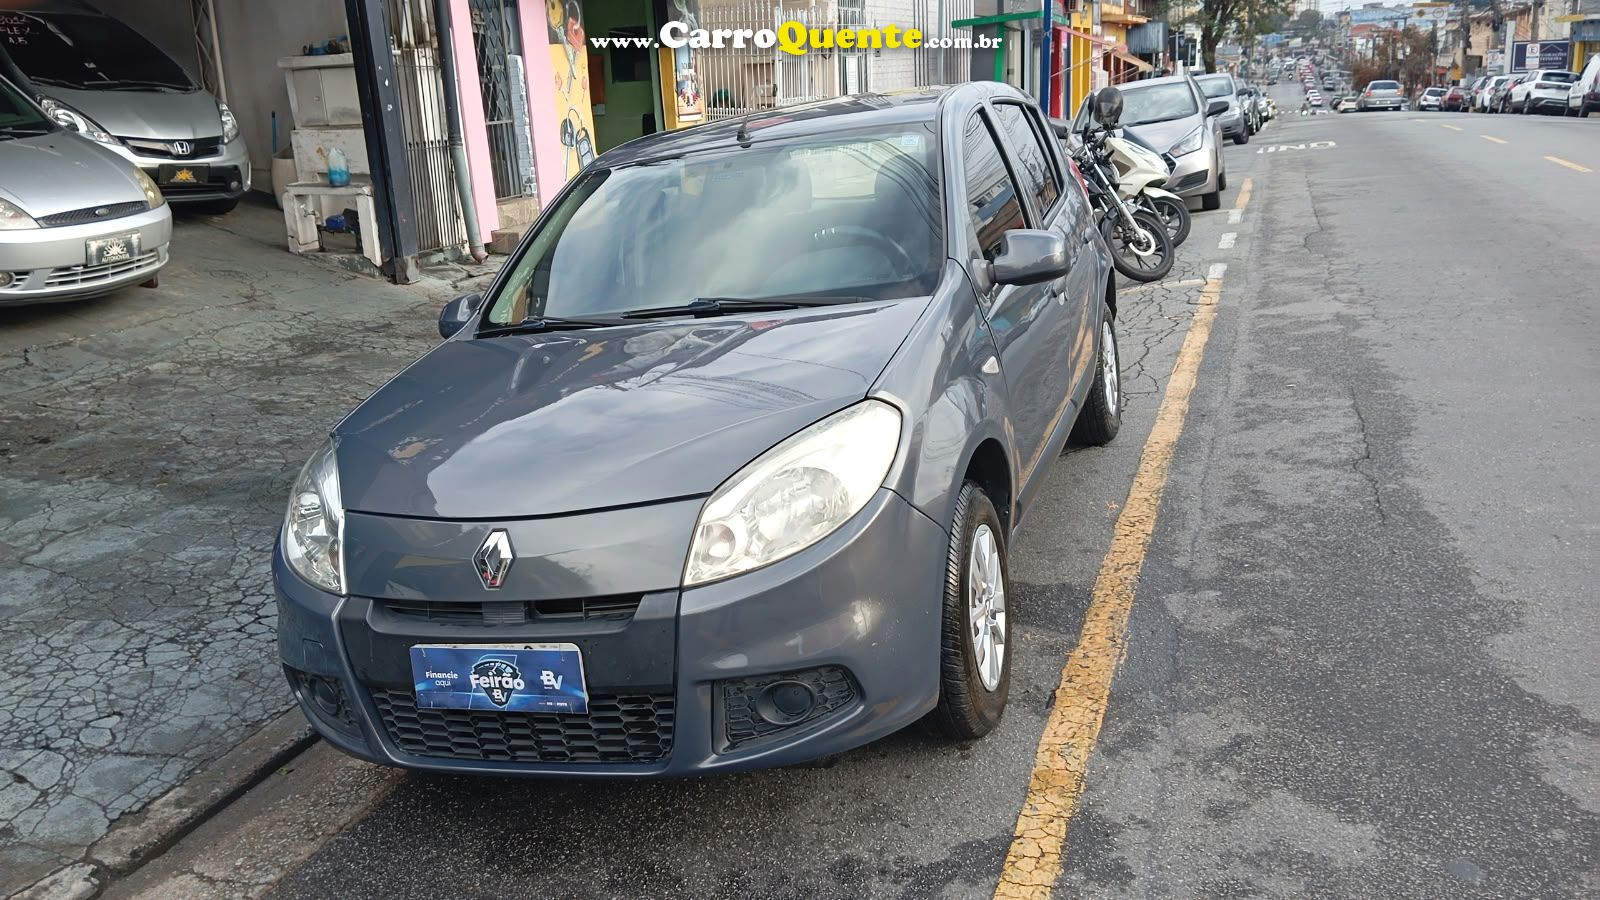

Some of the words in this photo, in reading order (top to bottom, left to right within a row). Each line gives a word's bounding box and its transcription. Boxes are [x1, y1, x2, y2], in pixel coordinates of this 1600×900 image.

[425, 670, 459, 679] Financie
[469, 671, 525, 690] Feirão
[540, 670, 563, 690] BV
[435, 679, 452, 688] aqui
[492, 688, 508, 702] BV
